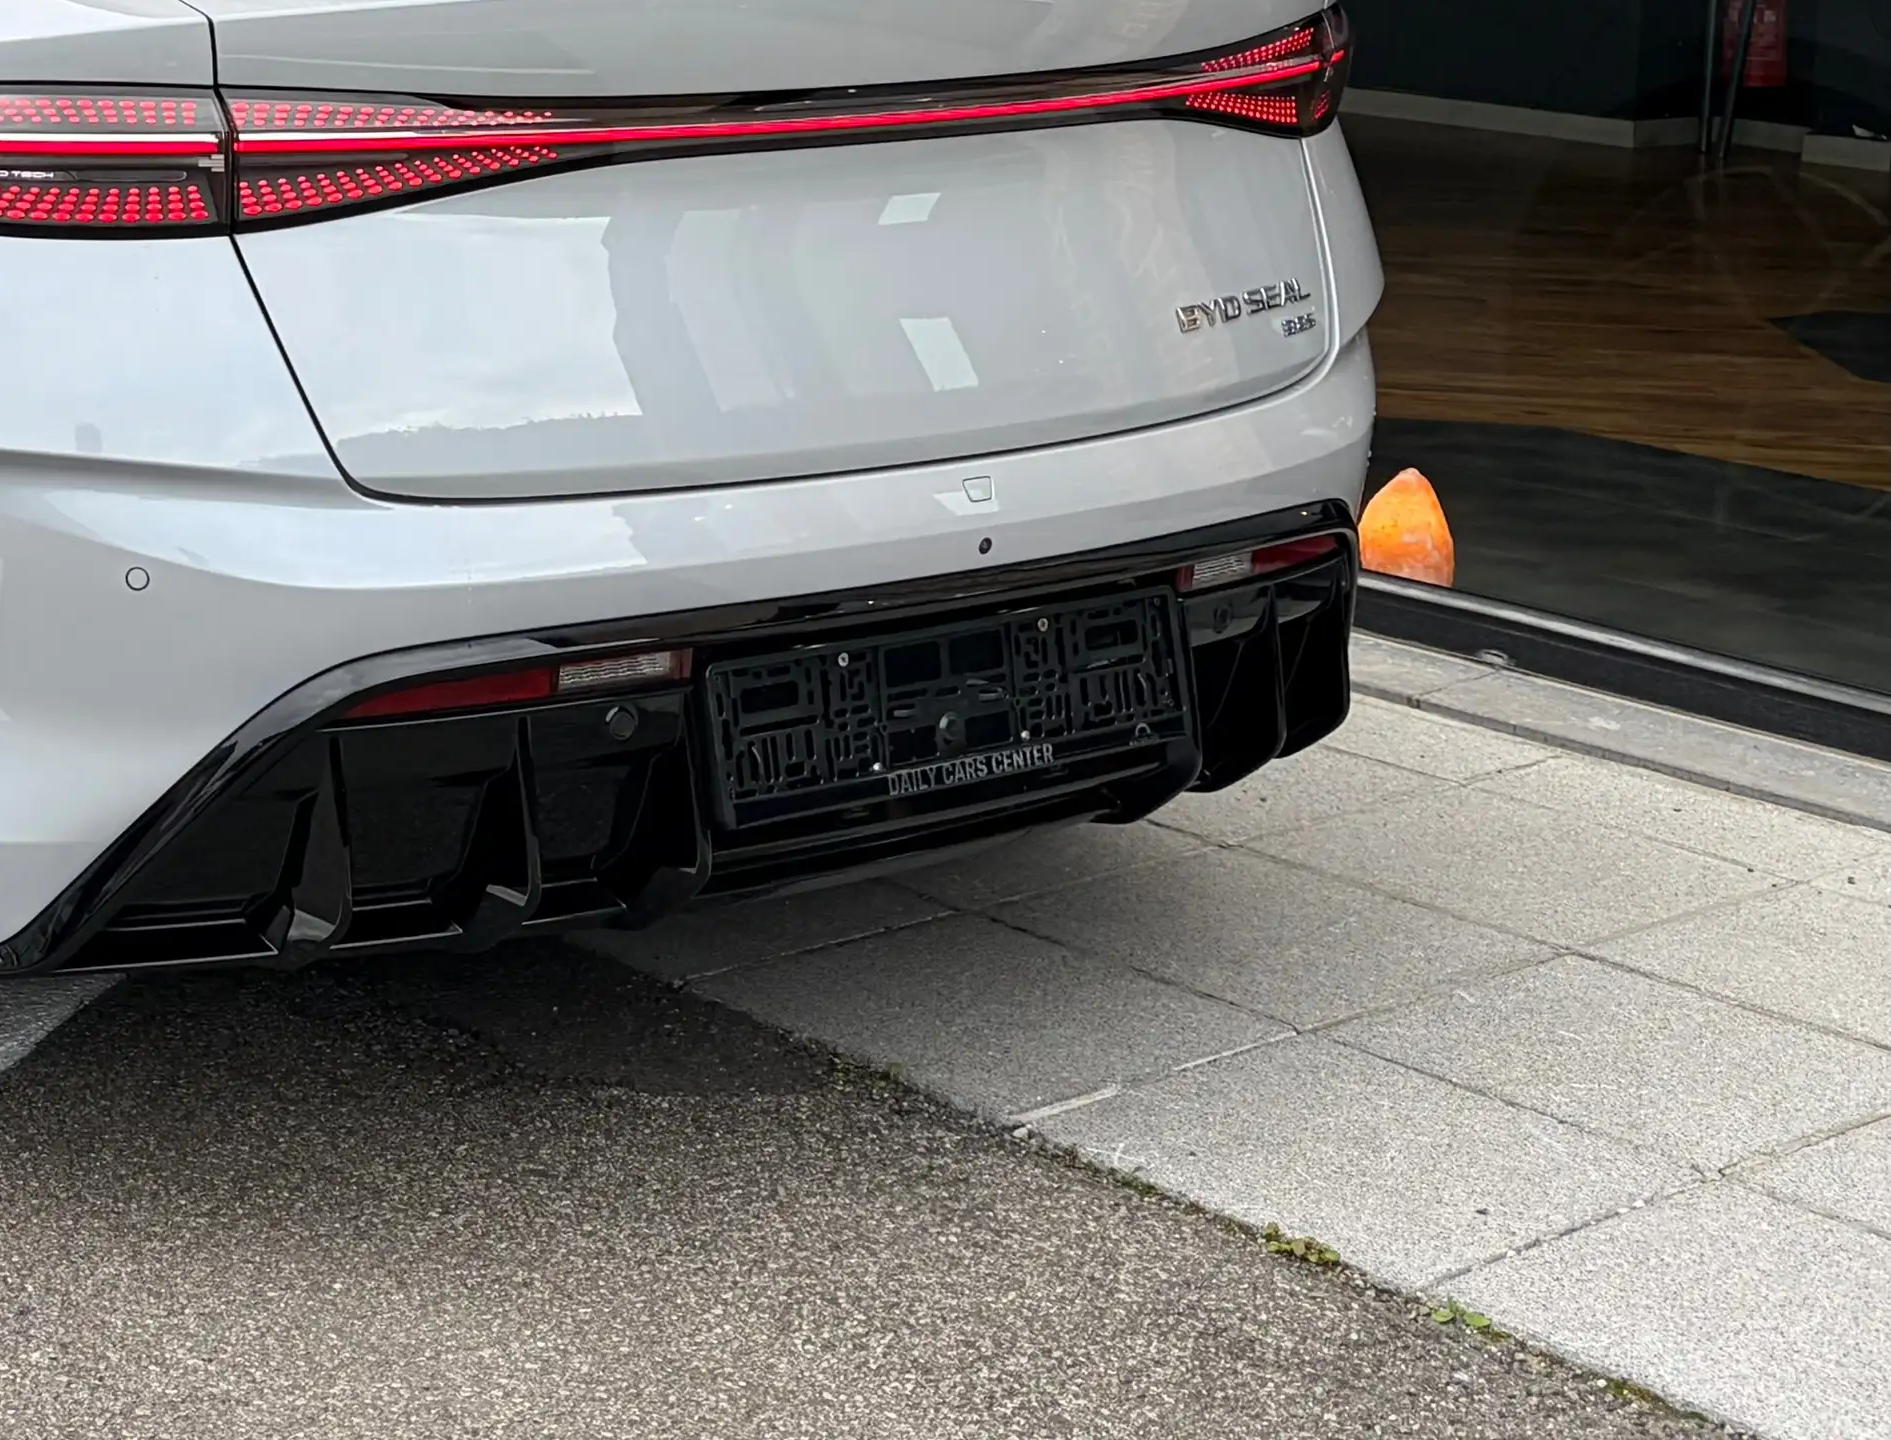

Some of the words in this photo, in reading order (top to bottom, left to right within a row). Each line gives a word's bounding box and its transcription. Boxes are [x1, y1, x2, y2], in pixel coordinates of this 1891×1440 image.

[10, 169, 54, 179] TECH
[1175, 294, 1241, 334] BYD
[1242, 277, 1311, 315] SEAL
[887, 764, 937, 797] DAILY
[941, 753, 988, 786] CARS
[992, 742, 1054, 775] CENTER
